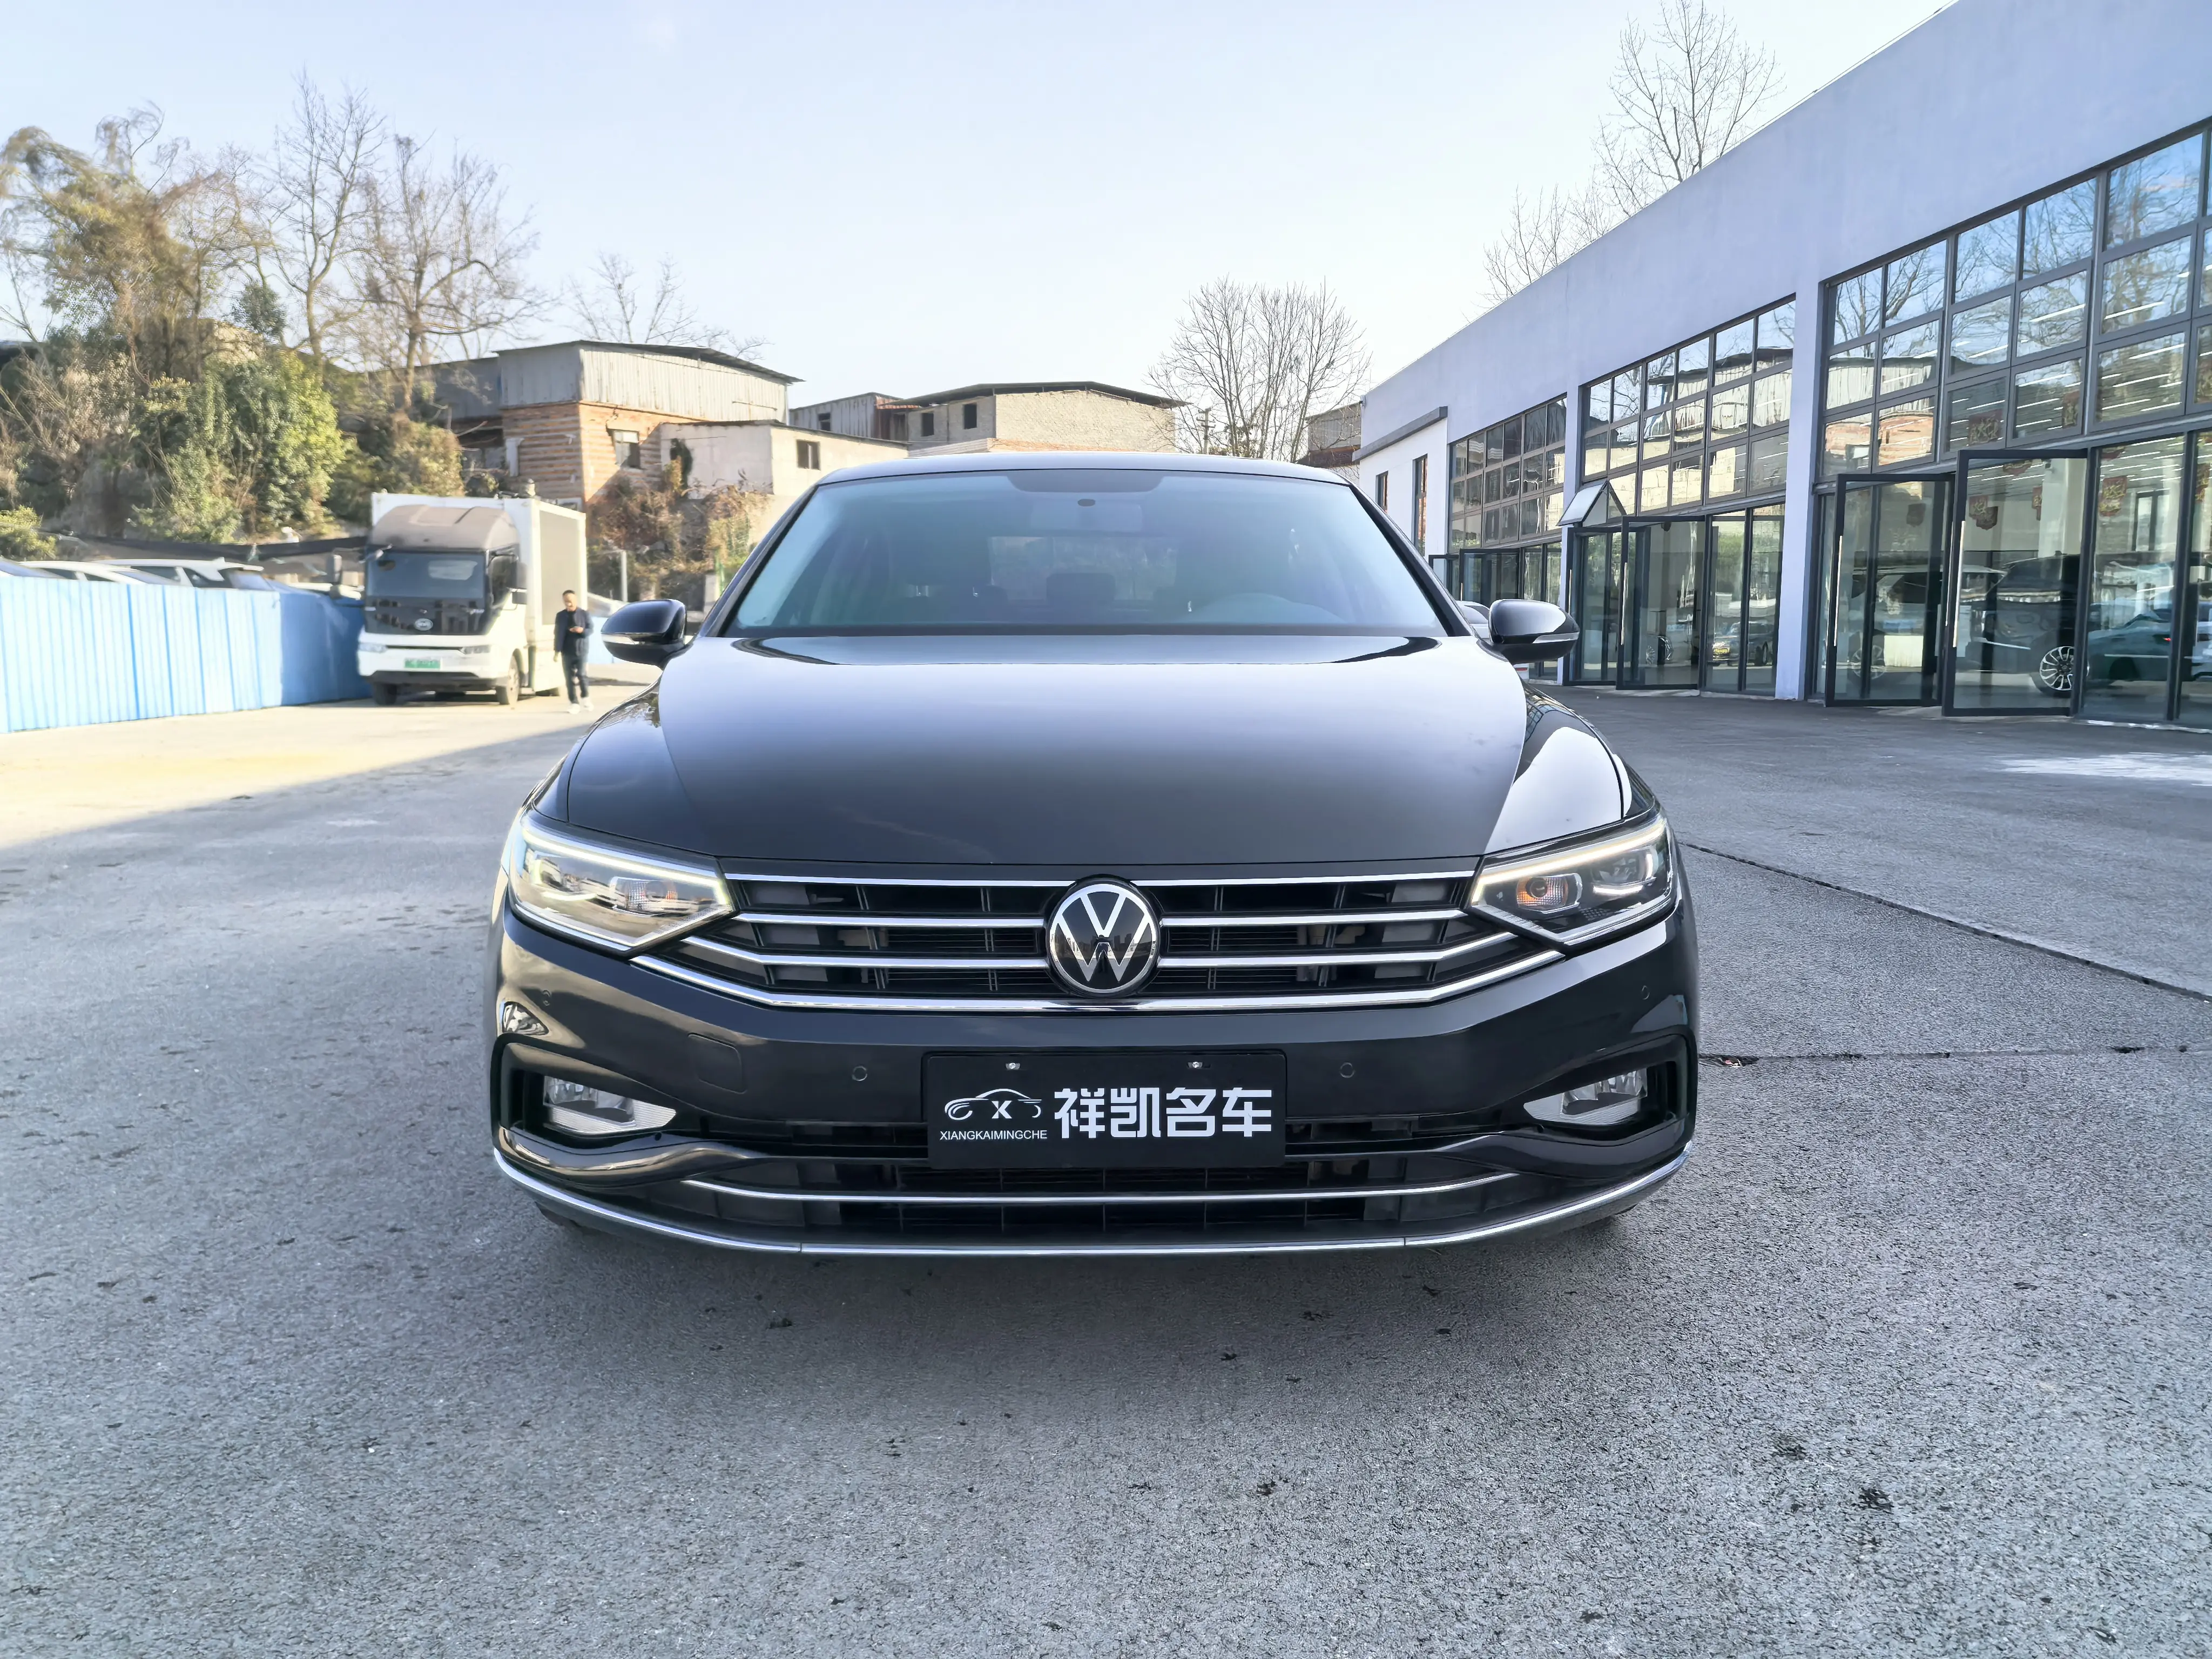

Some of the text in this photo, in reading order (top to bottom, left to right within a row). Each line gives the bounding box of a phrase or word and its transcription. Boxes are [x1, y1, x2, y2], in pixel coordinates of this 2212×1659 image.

[1054, 887, 1153, 987] VW
[940, 1130, 1048, 1140] XIANGKAIMINGCHE
[1054, 1087, 1272, 1139] 祥凯名车
